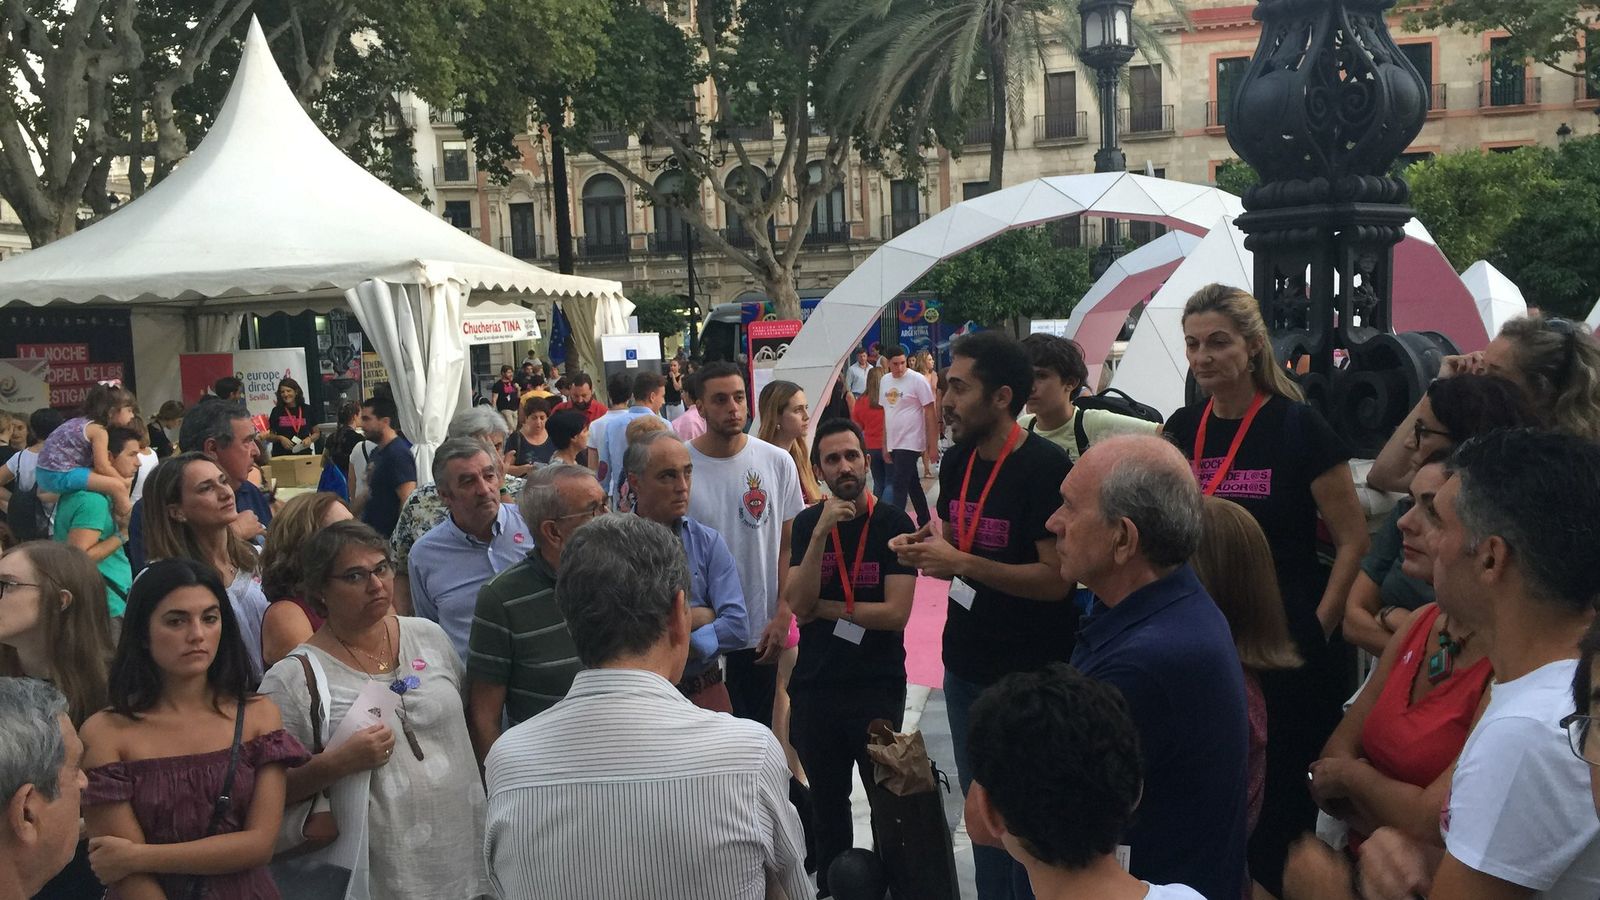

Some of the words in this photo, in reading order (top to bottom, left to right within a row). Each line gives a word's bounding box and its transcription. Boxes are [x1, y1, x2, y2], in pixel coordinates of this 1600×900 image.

[502, 320, 521, 332] TINA
[44, 346, 86, 361] NOCHE
[48, 367, 80, 382] OPEA
[84, 367, 97, 380] DE
[246, 370, 280, 382] europe
[248, 381, 276, 392] direct
[51, 387, 91, 404] STIGA
[249, 393, 270, 401] Sevilla
[1243, 470, 1268, 481] L@S
